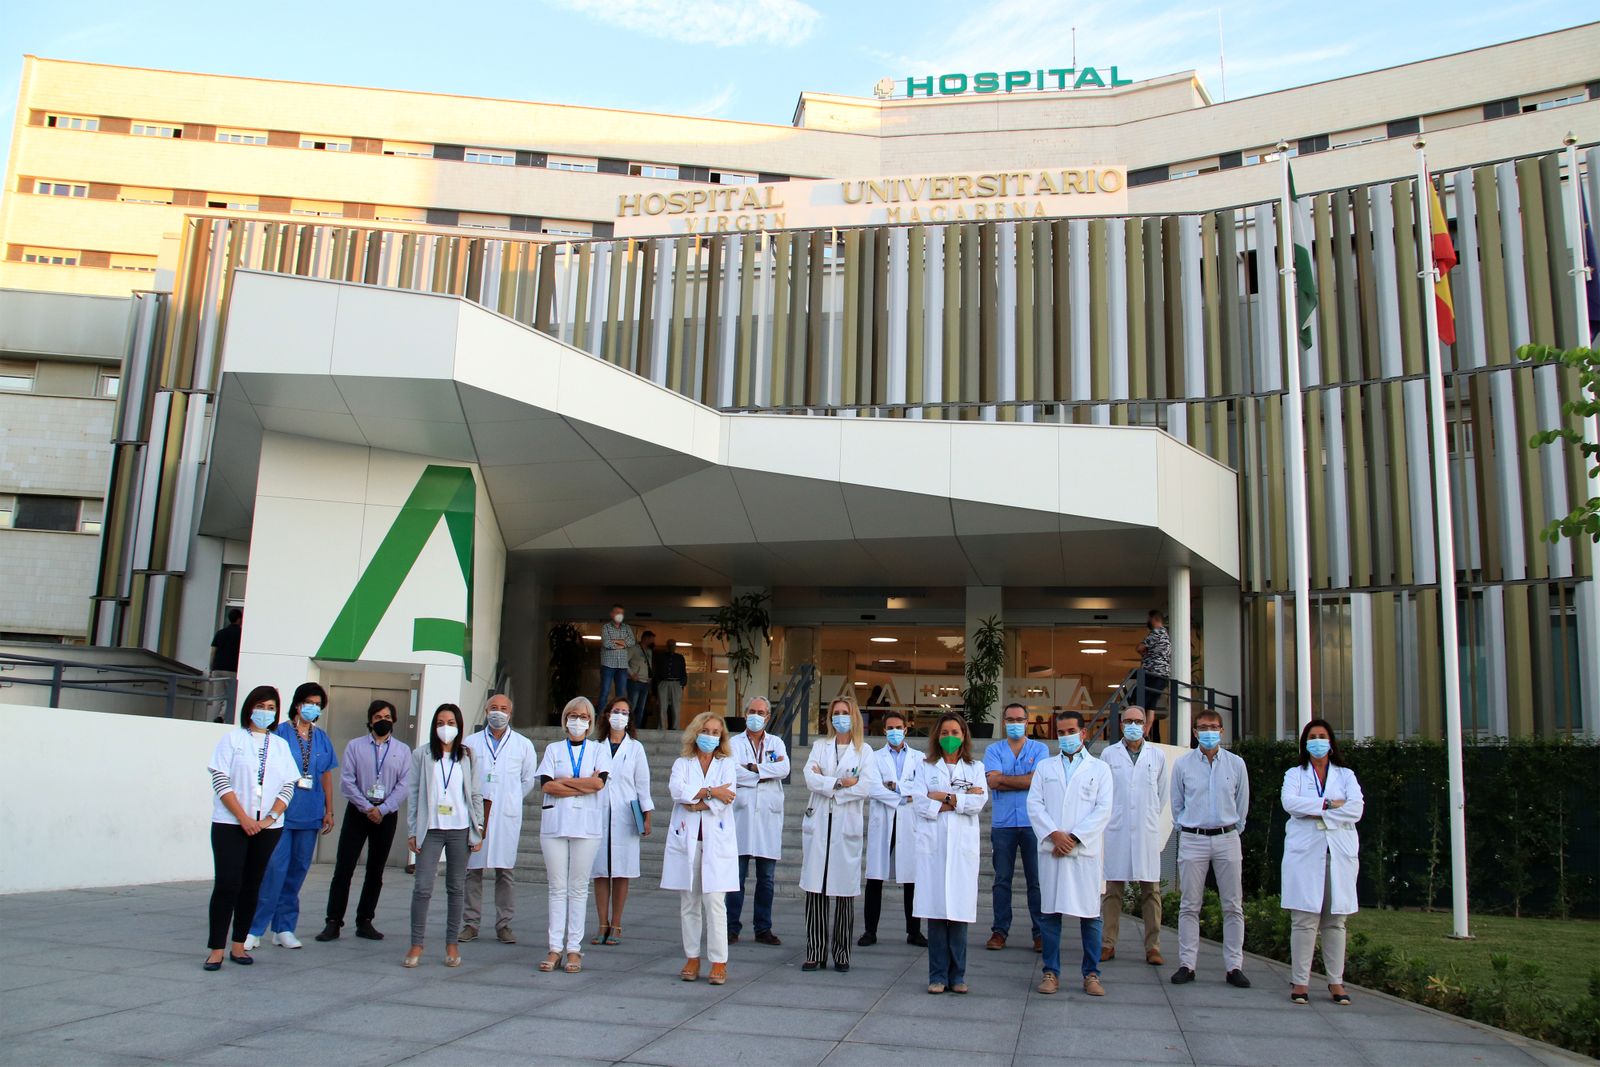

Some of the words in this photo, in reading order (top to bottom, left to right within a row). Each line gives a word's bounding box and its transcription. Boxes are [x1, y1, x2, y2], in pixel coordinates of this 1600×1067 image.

[907, 66, 1133, 97] HOSPITAL
[618, 187, 784, 217] HOSPITAL
[842, 169, 1122, 204] UNIVERSITARIO
[686, 214, 786, 234] VIRGEN
[887, 202, 1046, 222] MACARENA
